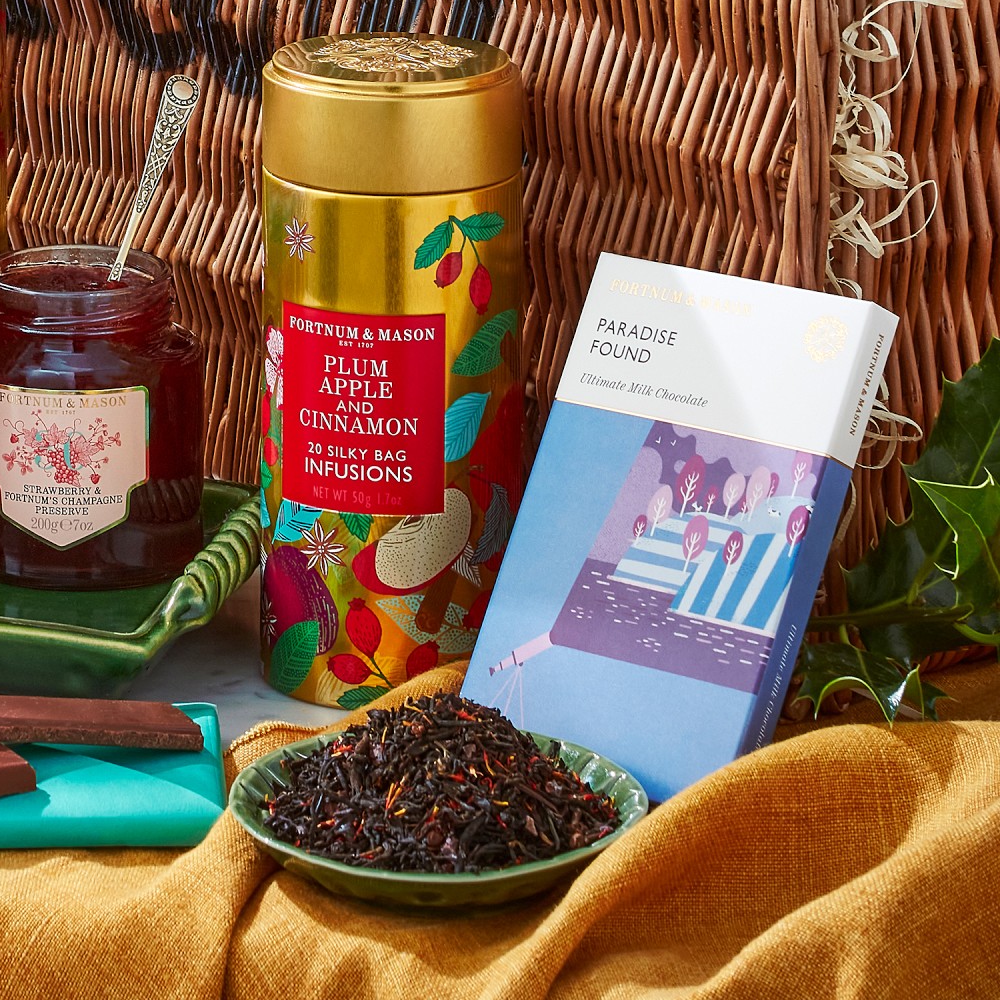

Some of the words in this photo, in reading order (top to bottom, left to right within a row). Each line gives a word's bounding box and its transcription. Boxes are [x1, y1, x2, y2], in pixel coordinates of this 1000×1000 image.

[609, 279, 683, 304] FORTNUM
[685, 292, 696, 307] &
[289, 315, 359, 340] FORTNUM
[362, 328, 374, 341] &
[378, 327, 436, 342] MASON
[596, 318, 678, 347] PARADISE
[589, 339, 651, 364] FOUND
[864, 334, 885, 388] FORTNUM
[324, 354, 389, 378] PLUM
[318, 376, 393, 399] APPLE
[579, 372, 627, 392] Ultimate
[627, 382, 654, 398] Milk
[654, 386, 709, 408] Chocolate
[861, 387, 868, 396] &
[0, 392, 63, 409] FORTNUM
[66, 399, 75, 408] &
[79, 396, 127, 409] MASON
[336, 400, 374, 415] AND
[299, 407, 419, 436] CINNAMON
[849, 397, 865, 436] MASON
[307, 441, 323, 454] 20
[327, 445, 368, 460] SILKY
[374, 449, 407, 462] BAG
[304, 456, 413, 483] INFUSIONS
[4, 491, 59, 505] FORTNUM'S
[61, 495, 123, 505] CHAMPAGNE
[23, 484, 93, 496] STRAWBERRY
[94, 486, 102, 495] &
[313, 485, 329, 499] NET
[333, 488, 348, 501] WT
[352, 490, 372, 509] 50g
[377, 492, 402, 506] 1.7oz
[35, 506, 89, 516] PRESERVE
[779, 624, 798, 672] Ultimate
[770, 673, 784, 699] Milk
[755, 699, 776, 750] Chocolat
